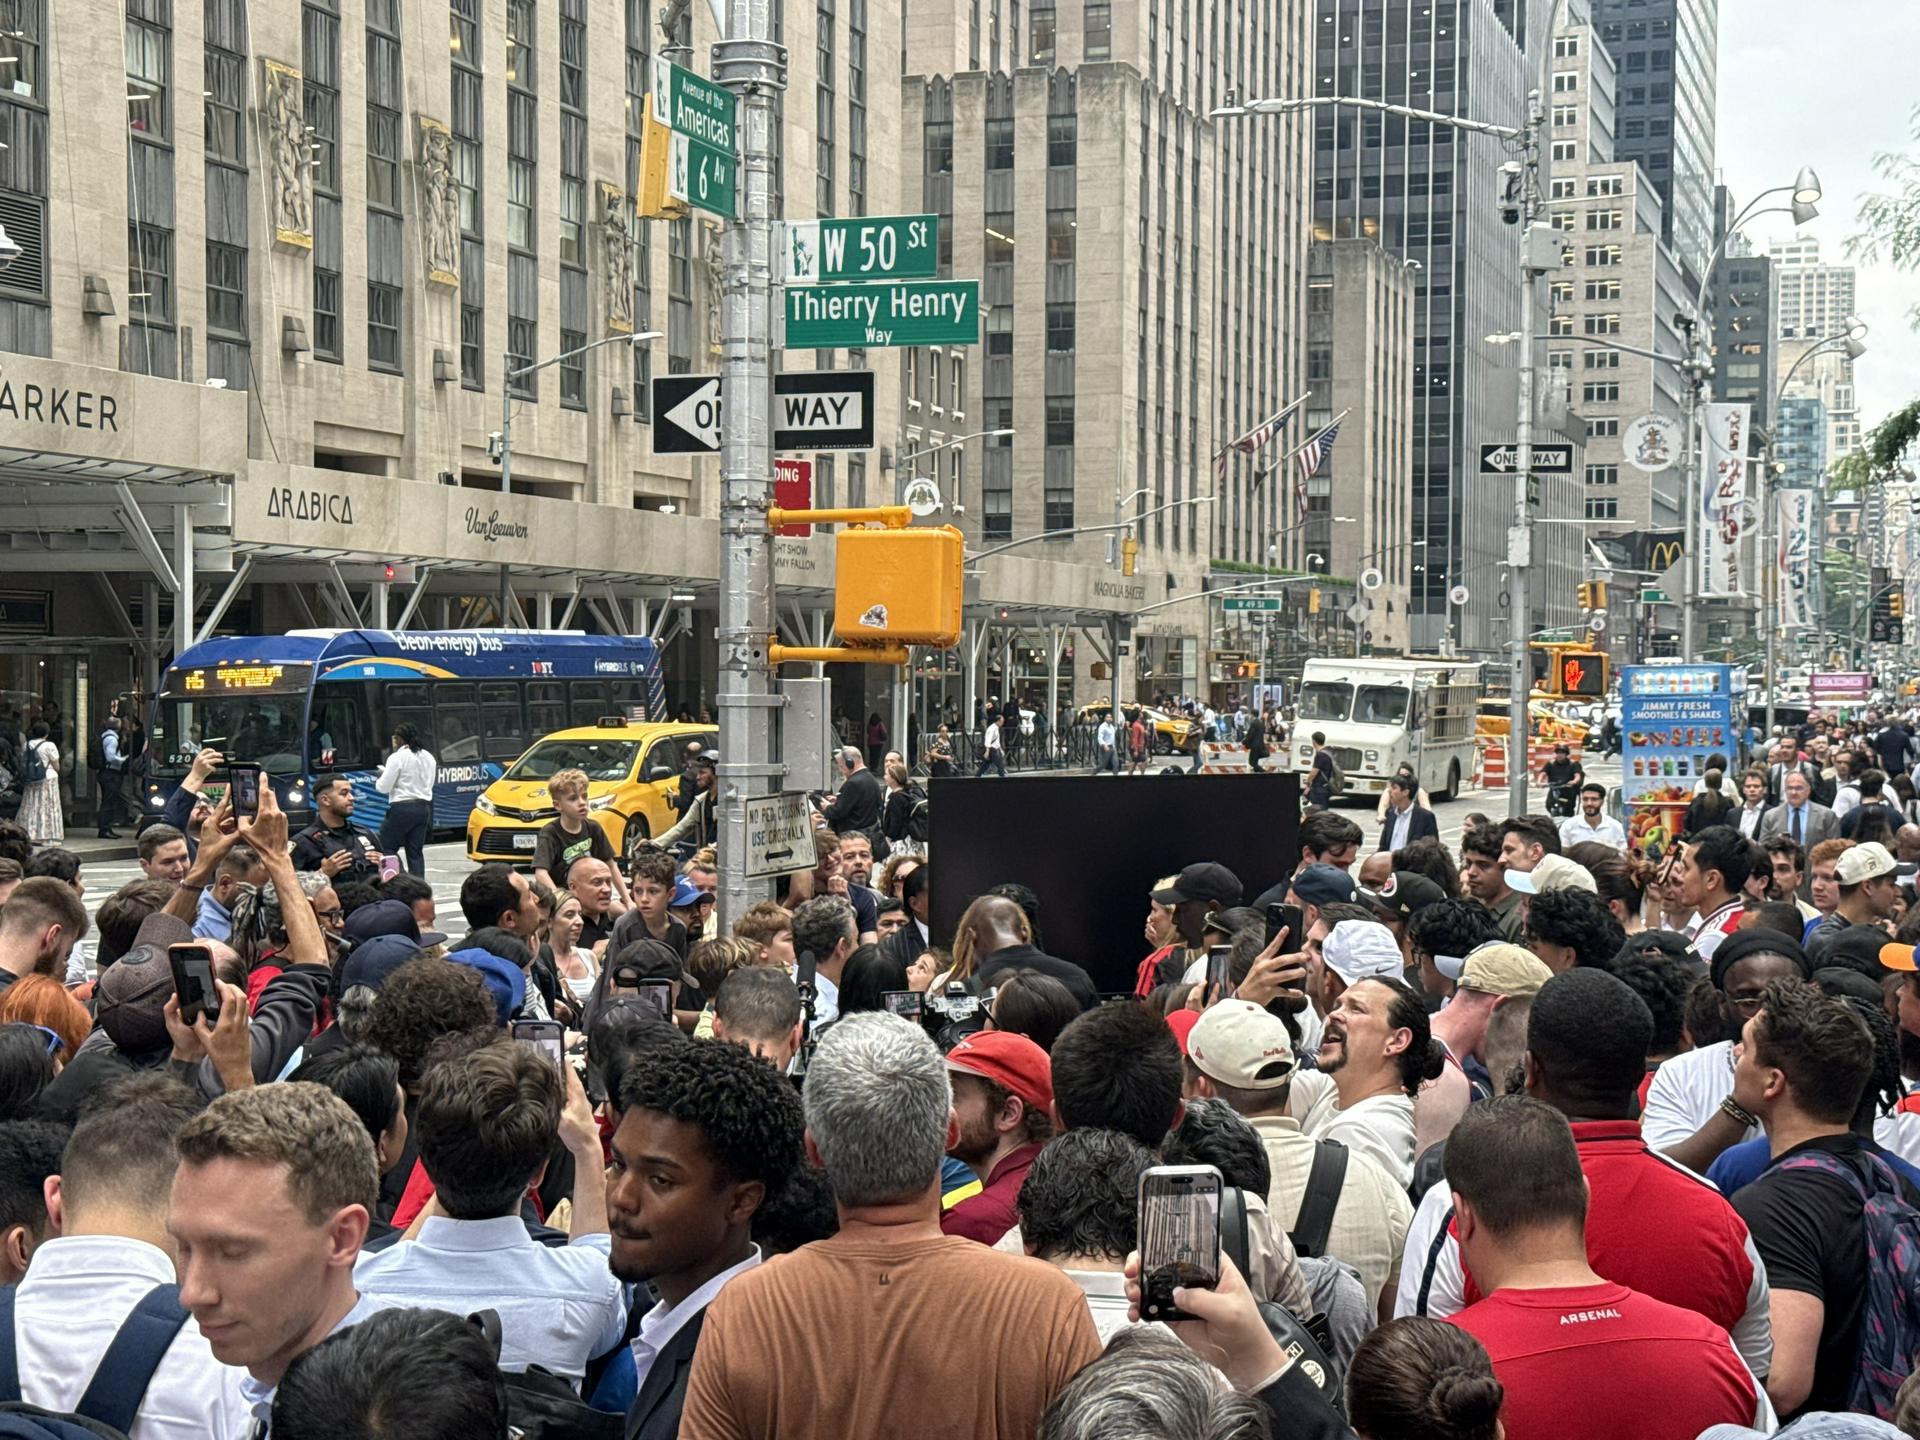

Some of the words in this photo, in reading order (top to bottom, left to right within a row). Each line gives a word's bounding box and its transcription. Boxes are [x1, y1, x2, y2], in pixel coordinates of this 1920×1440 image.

[681, 76, 705, 102] Avenue
[705, 89, 712, 105] of
[713, 91, 724, 110] the
[676, 94, 729, 147] Americas
[698, 153, 708, 200] 6
[713, 155, 726, 184] Av
[824, 228, 847, 272] W
[860, 225, 897, 272] 50
[907, 221, 928, 248] St
[790, 289, 880, 326] Thierry
[891, 287, 967, 324] Henry
[865, 327, 893, 346] Way
[785, 396, 850, 427] WAY
[1494, 453, 1518, 465] ONE
[1532, 453, 1560, 465] WAY
[267, 486, 354, 525] ARABICA
[788, 543, 808, 556] SHOW
[790, 558, 816, 570] FALLON
[398, 632, 478, 656] clean-energy
[476, 632, 503, 651] bus
[1631, 711, 1680, 720] SMOOTHIES
[1688, 711, 1722, 719] SHAKES
[1641, 702, 1676, 711] JIMMY
[1677, 701, 1711, 710] FRESH
[749, 809, 759, 824] NO
[778, 802, 806, 822] CROSSING
[752, 830, 766, 847] USE
[768, 825, 806, 845] CROSSWALK
[1559, 1308, 1622, 1325] ARSENAL
